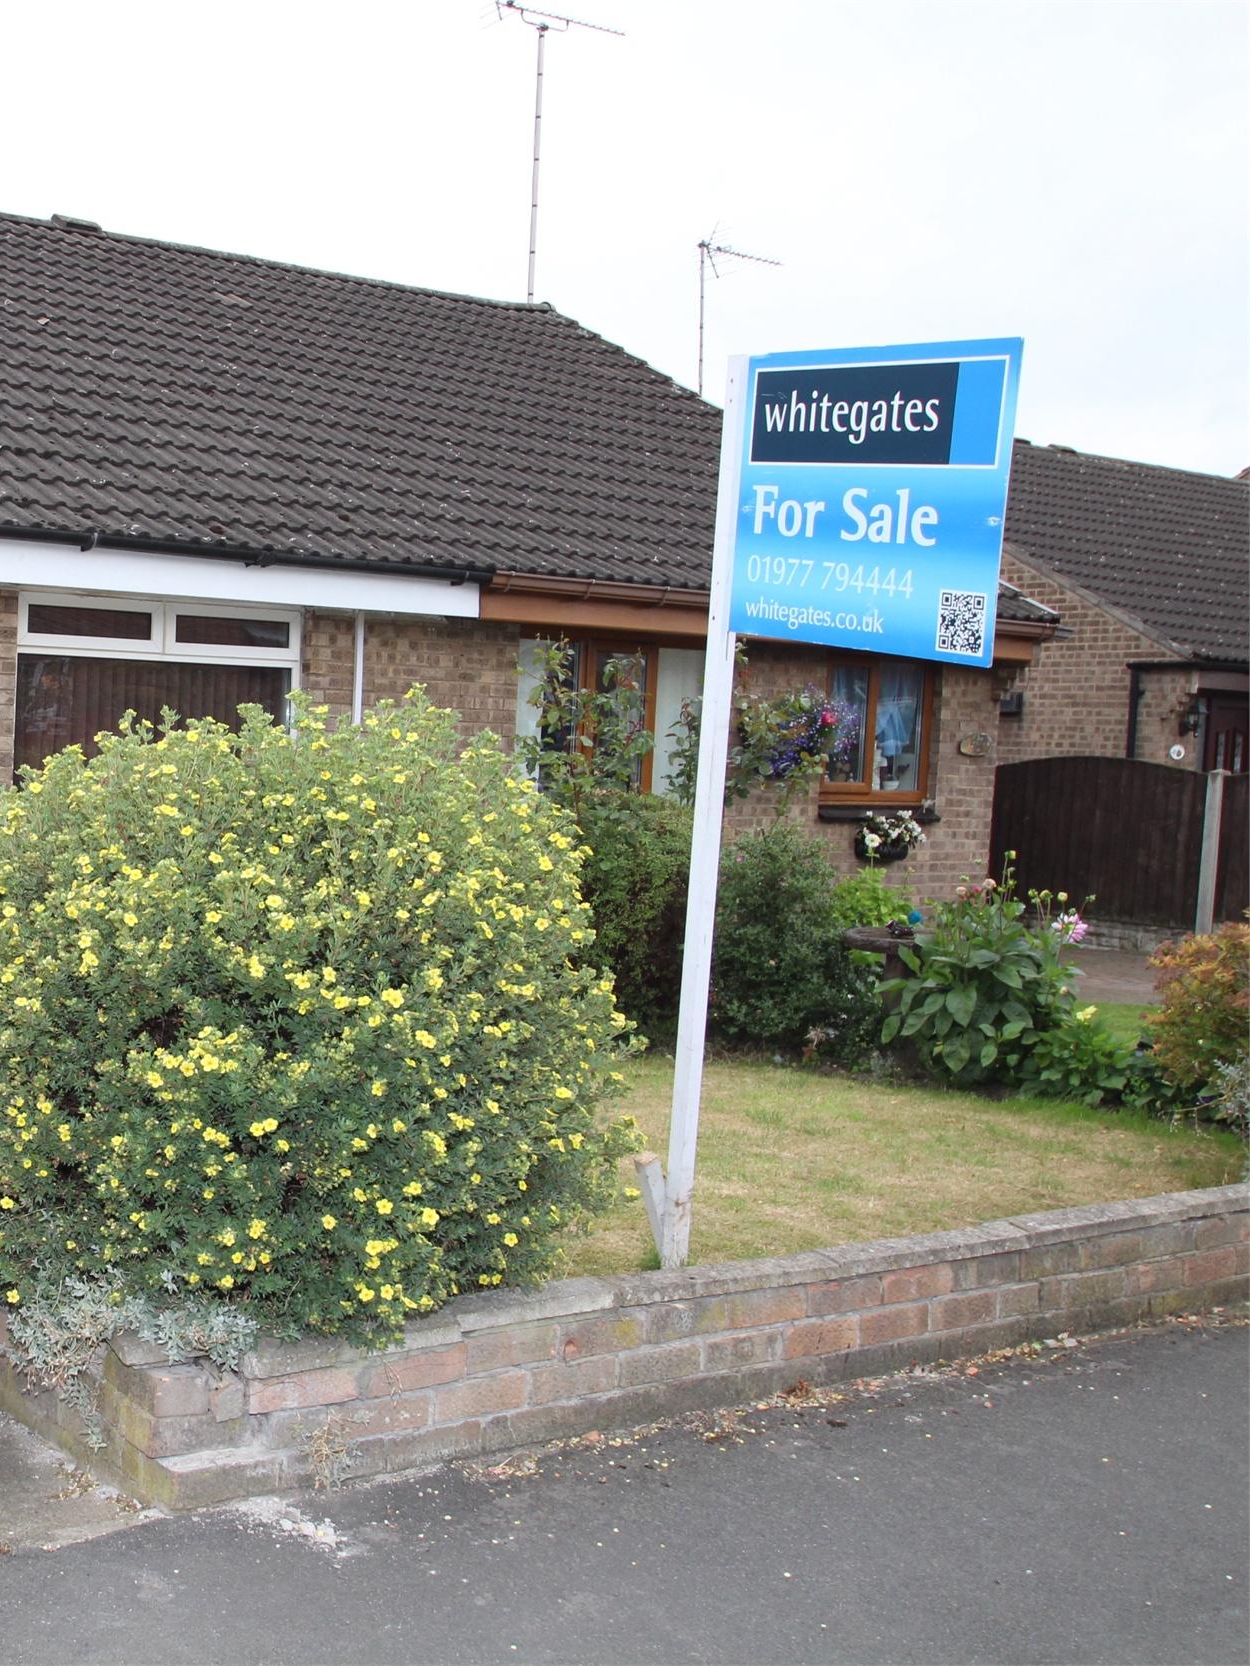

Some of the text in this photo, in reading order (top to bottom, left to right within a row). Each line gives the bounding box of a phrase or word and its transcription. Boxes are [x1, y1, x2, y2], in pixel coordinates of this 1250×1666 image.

[764, 390, 940, 444] whitegates
[753, 485, 939, 547] For Sale
[748, 555, 913, 599] 01977 794444
[745, 596, 884, 634] whitegates.co.uk
